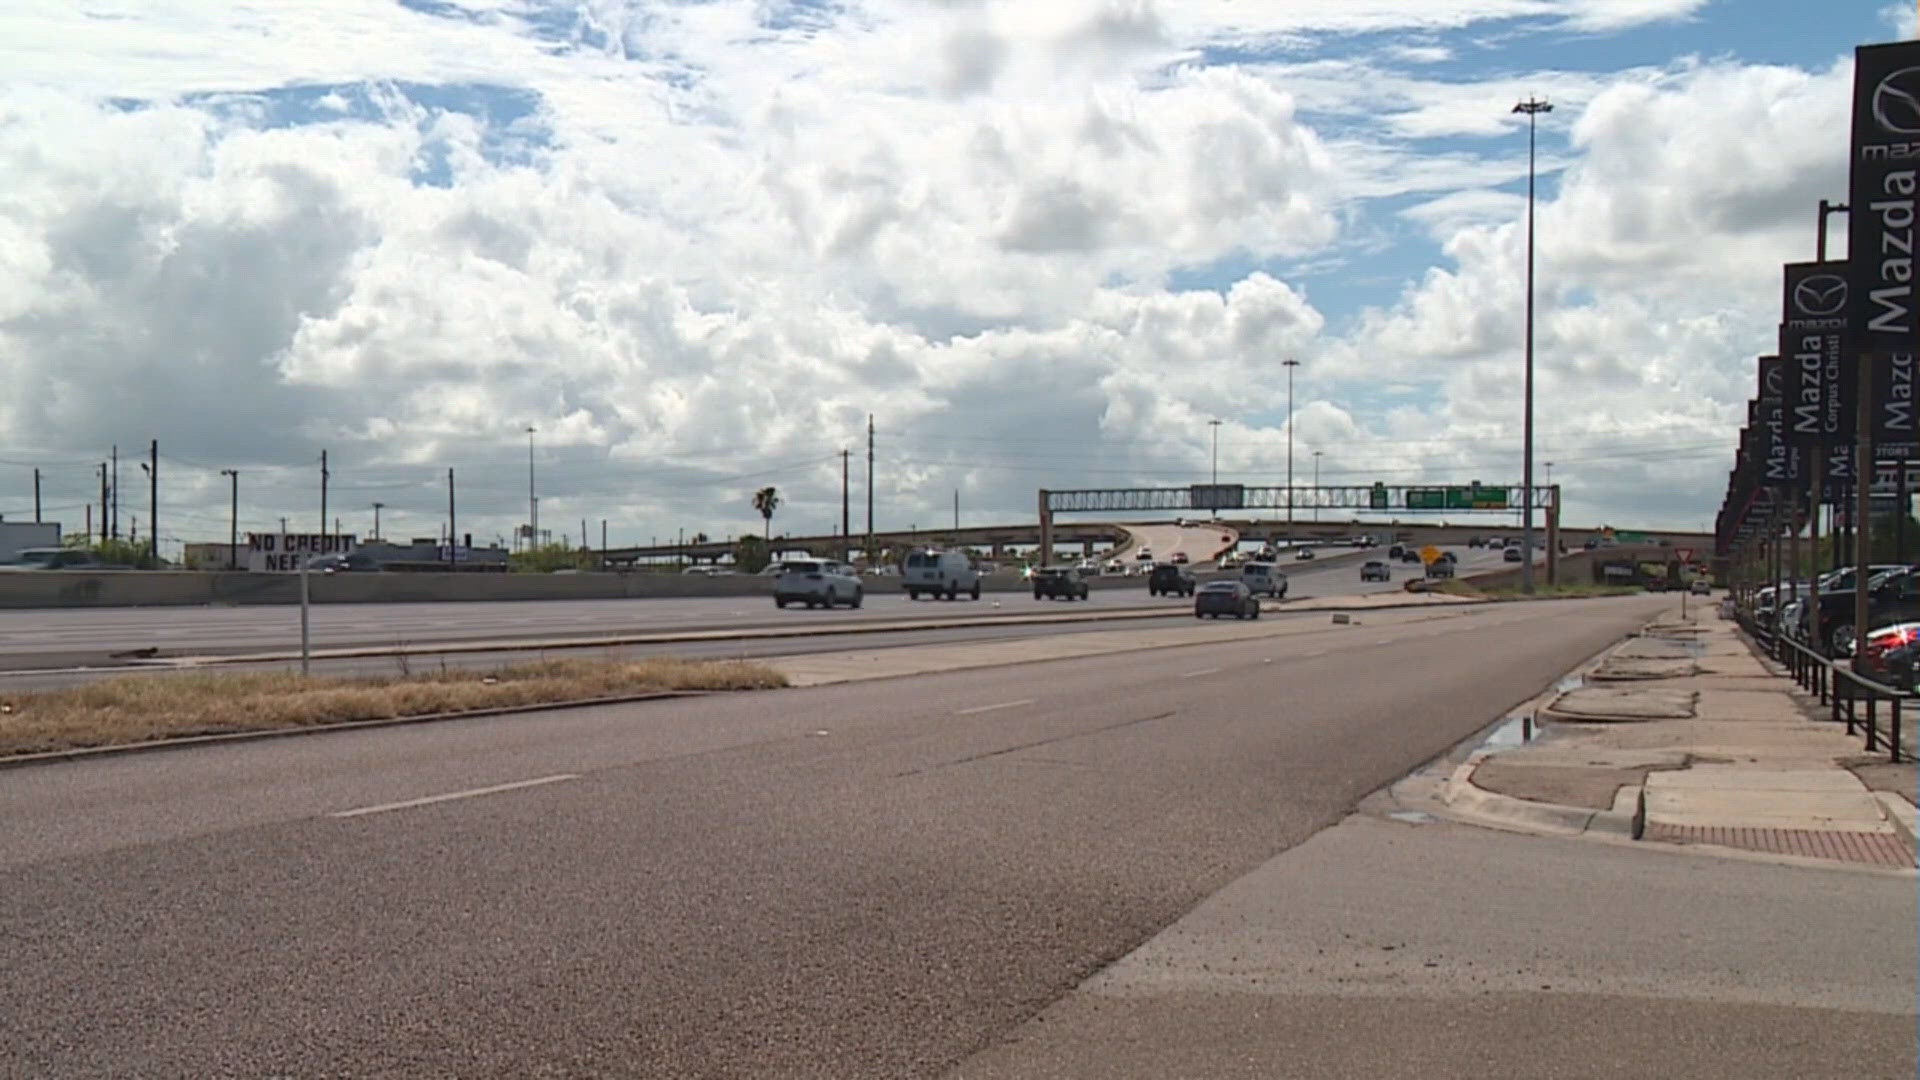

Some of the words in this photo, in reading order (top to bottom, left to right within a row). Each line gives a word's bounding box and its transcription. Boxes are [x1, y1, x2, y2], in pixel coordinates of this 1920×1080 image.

[1867, 170, 1916, 332] Mazda
[1825, 334, 1840, 381] Christi
[1794, 335, 1822, 434] Mazda
[1825, 383, 1842, 433] Corpus
[249, 532, 275, 552] NO
[285, 533, 354, 553] CREDIT
